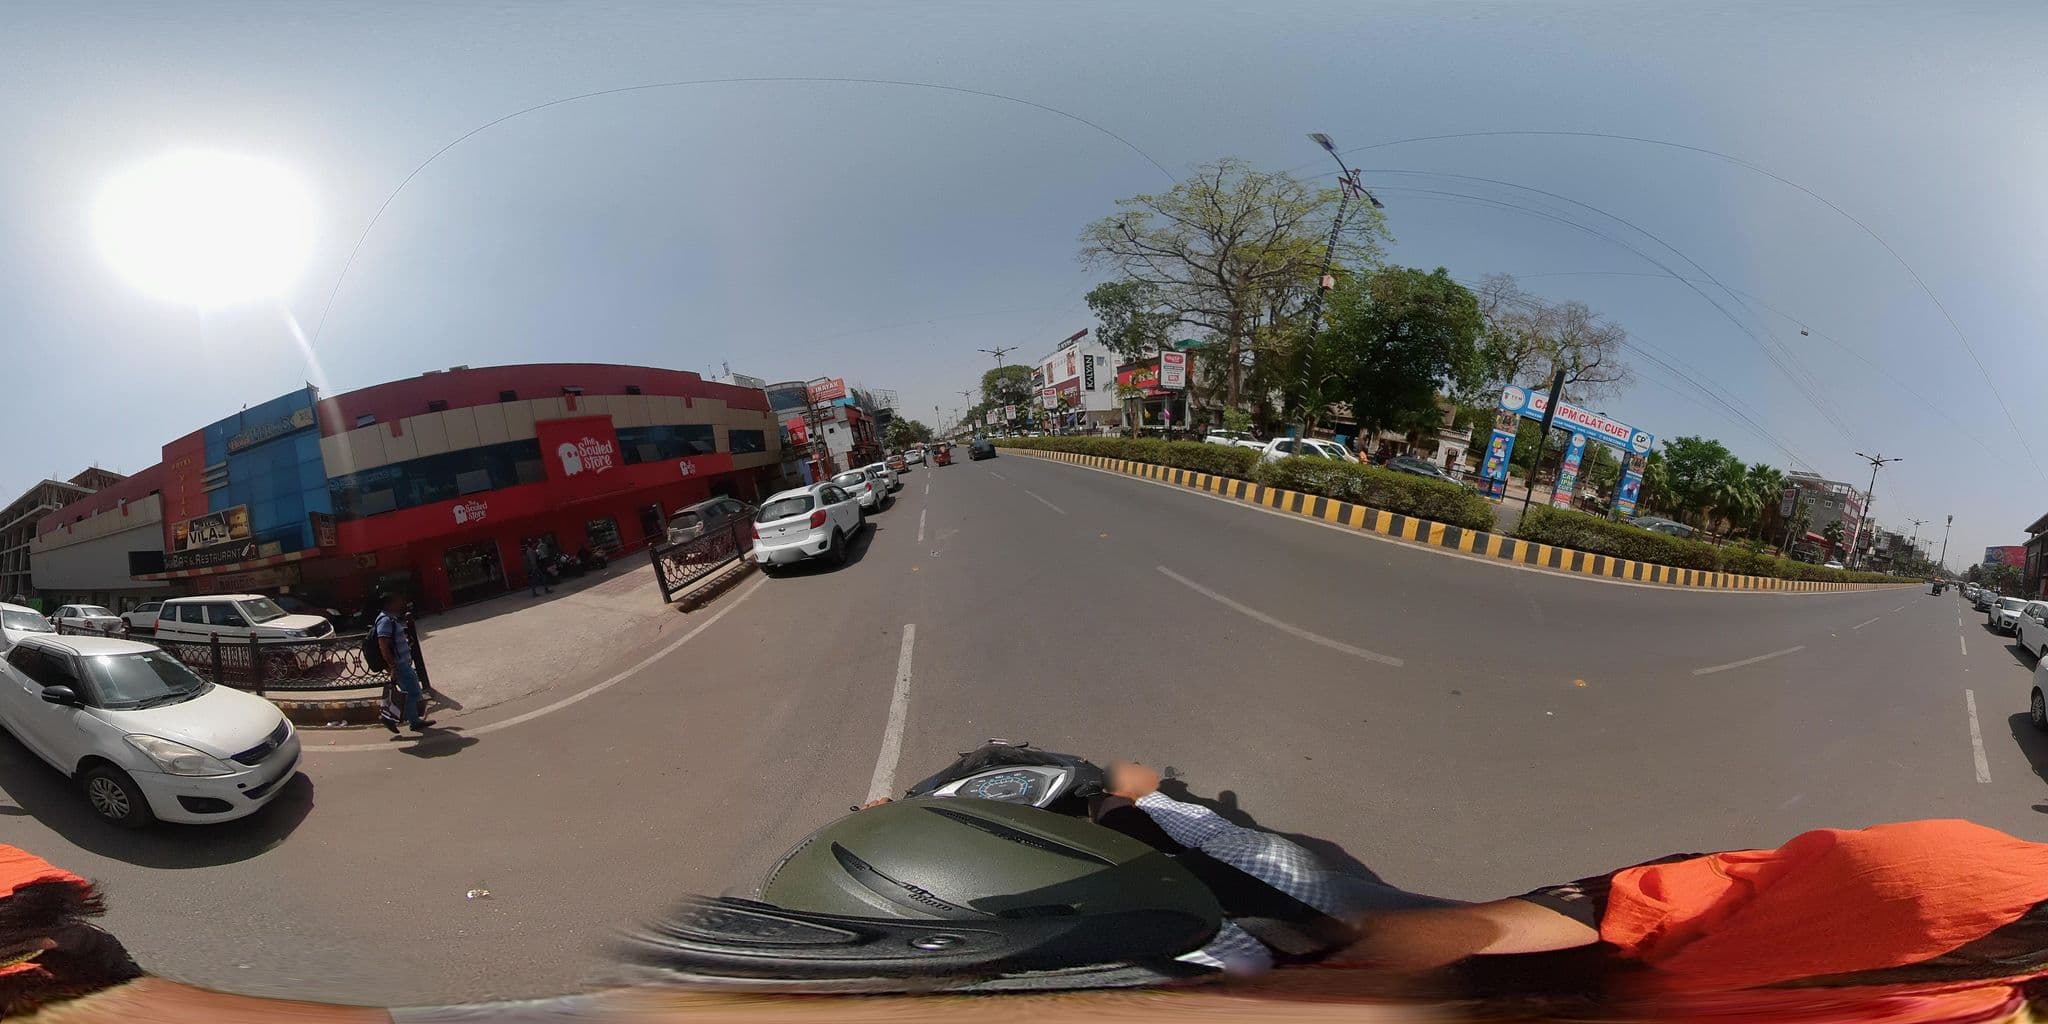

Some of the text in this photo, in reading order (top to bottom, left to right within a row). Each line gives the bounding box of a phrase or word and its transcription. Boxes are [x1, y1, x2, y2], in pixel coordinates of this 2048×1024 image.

[1085, 357, 1093, 387] KALYAN
[1557, 406, 1578, 421] IPM
[1578, 413, 1604, 429] CLAT
[1604, 423, 1630, 439] CUET
[578, 440, 613, 457] Souled
[581, 436, 596, 446] The
